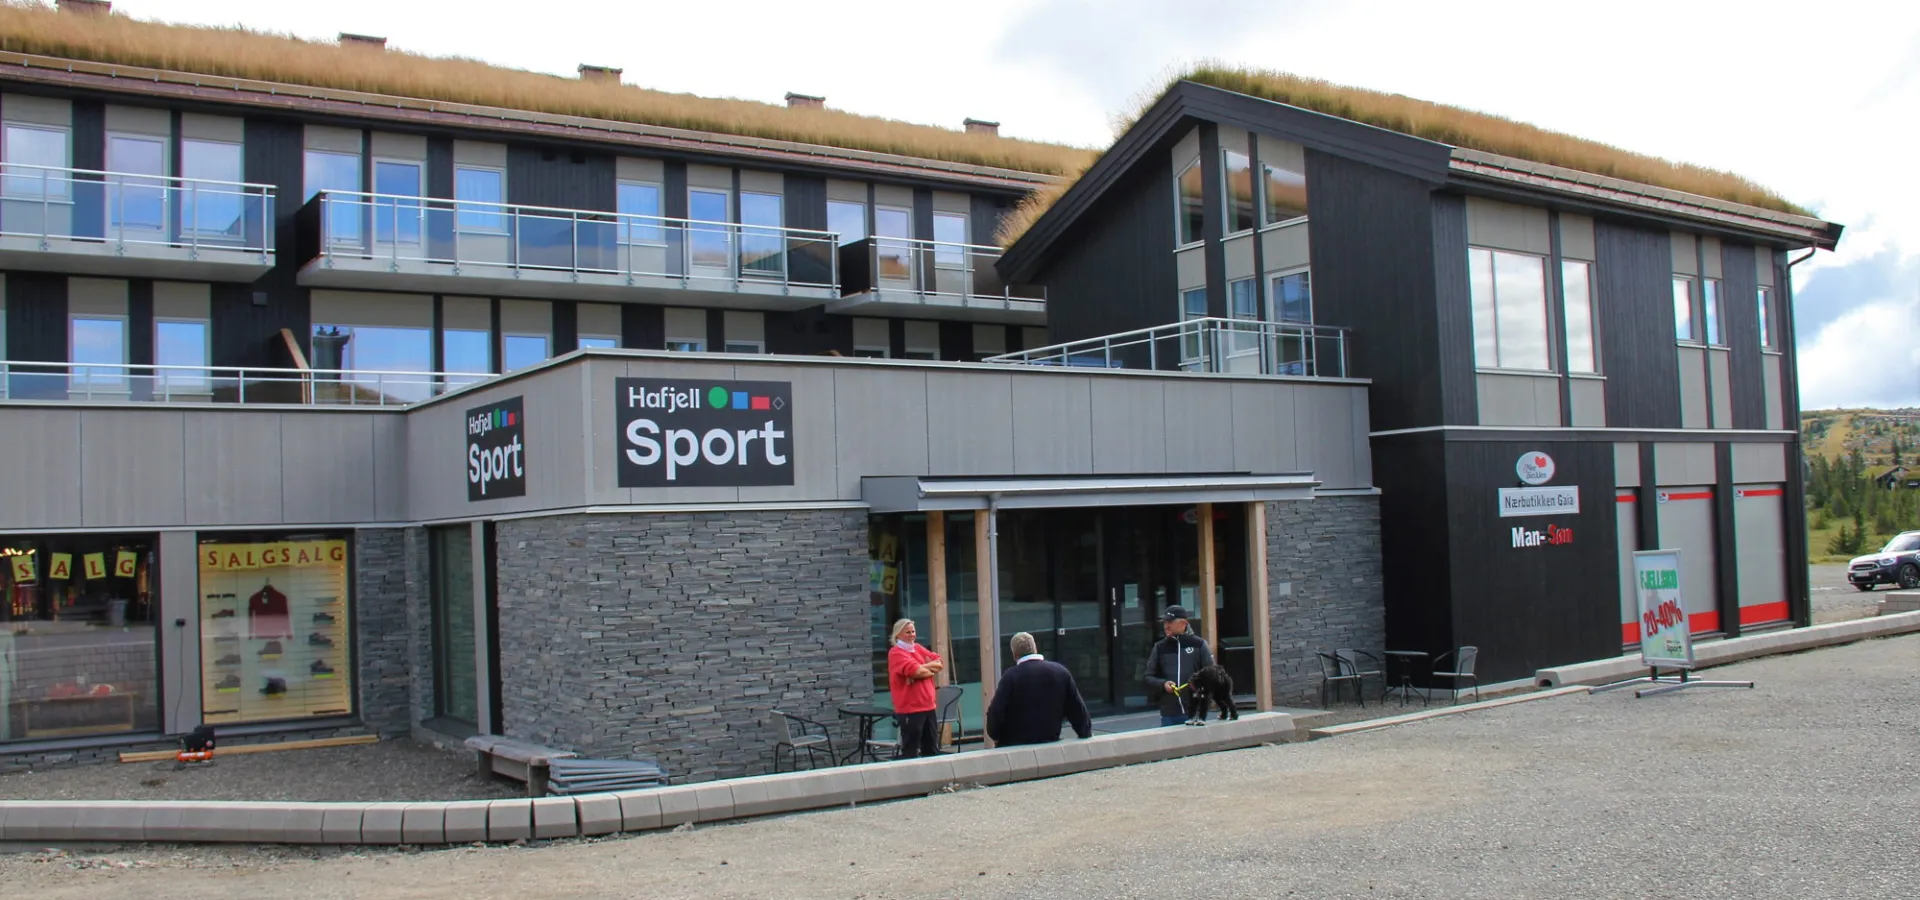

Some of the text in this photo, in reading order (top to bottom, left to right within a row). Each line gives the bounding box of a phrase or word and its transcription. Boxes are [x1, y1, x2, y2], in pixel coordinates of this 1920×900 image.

[629, 386, 700, 413] Hafjell
[469, 412, 492, 436] Hafjell
[626, 418, 787, 480] Sport
[469, 434, 523, 495] Sport
[1505, 494, 1574, 508] Nærbutikken Gaia
